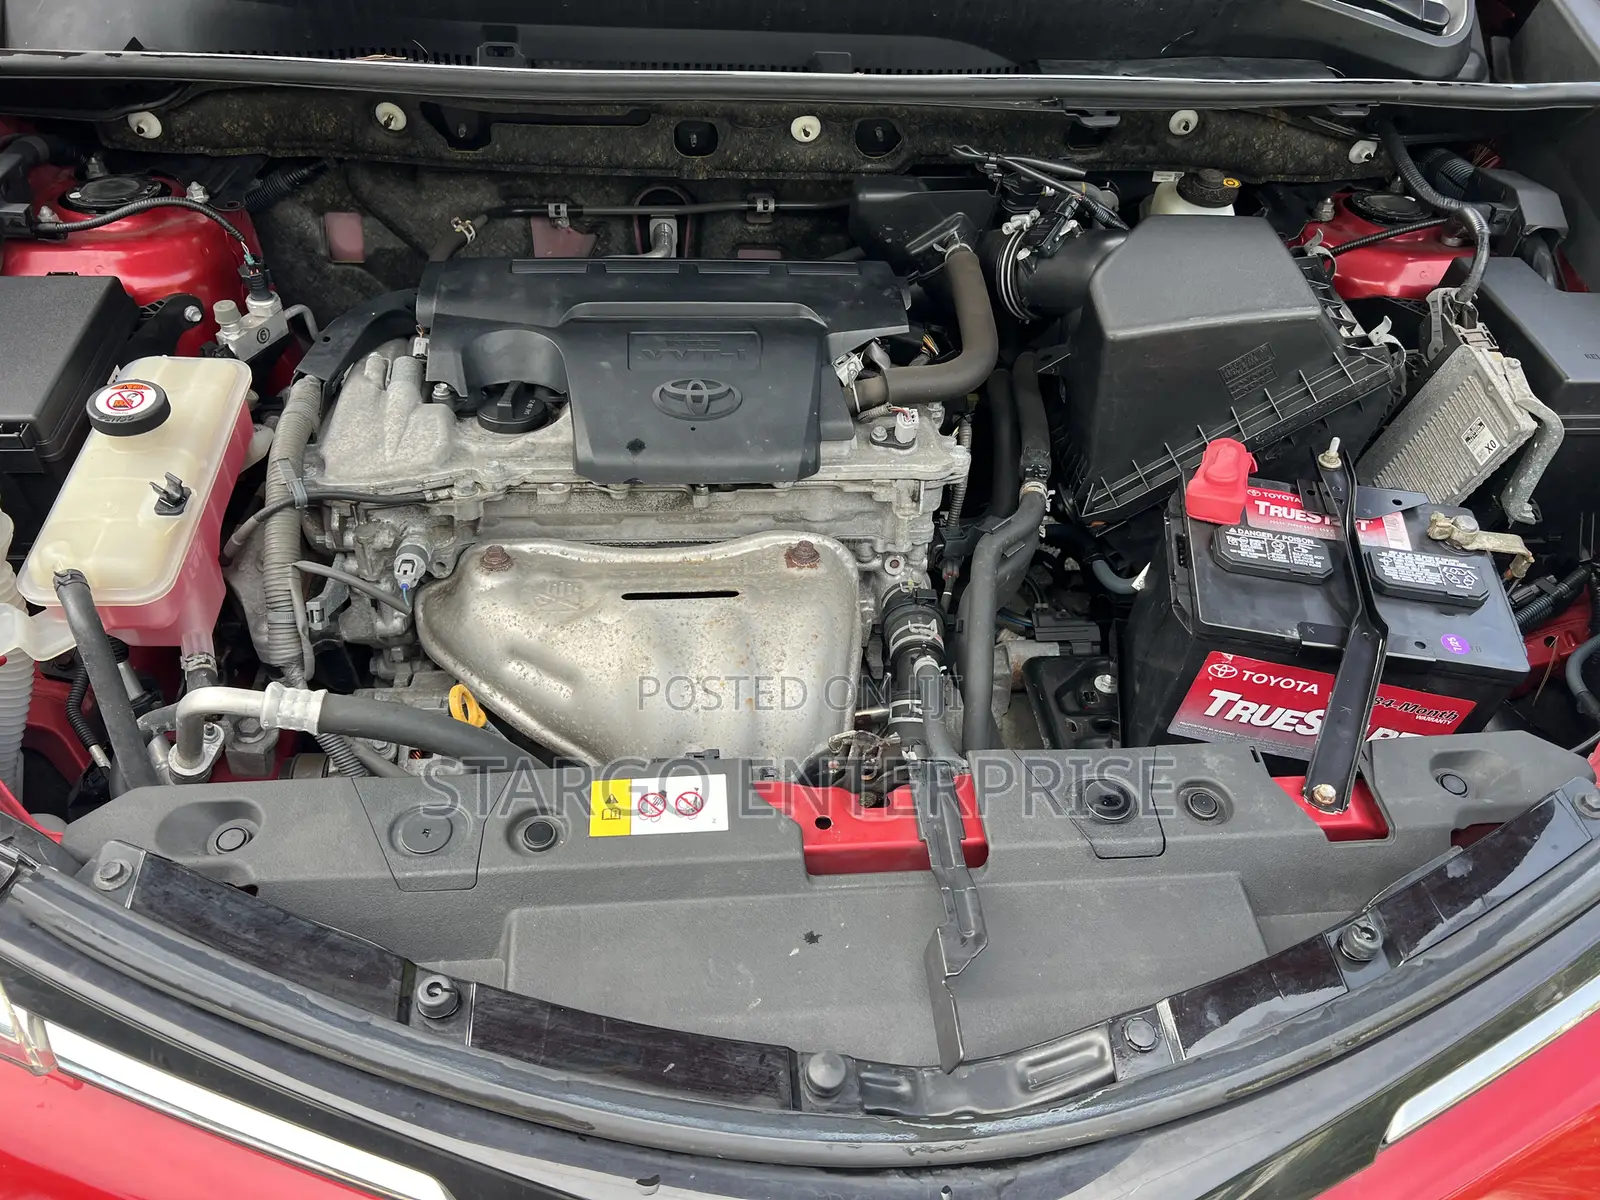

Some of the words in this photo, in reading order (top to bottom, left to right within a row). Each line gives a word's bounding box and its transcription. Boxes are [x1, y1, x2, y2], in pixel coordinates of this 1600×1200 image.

[1262, 491, 1303, 504] TOYOTA
[1237, 528, 1273, 540] DANGER
[1282, 535, 1314, 546] POISON
[1242, 669, 1320, 696] TOYOTA
[1415, 714, 1453, 726] WARRANTY
